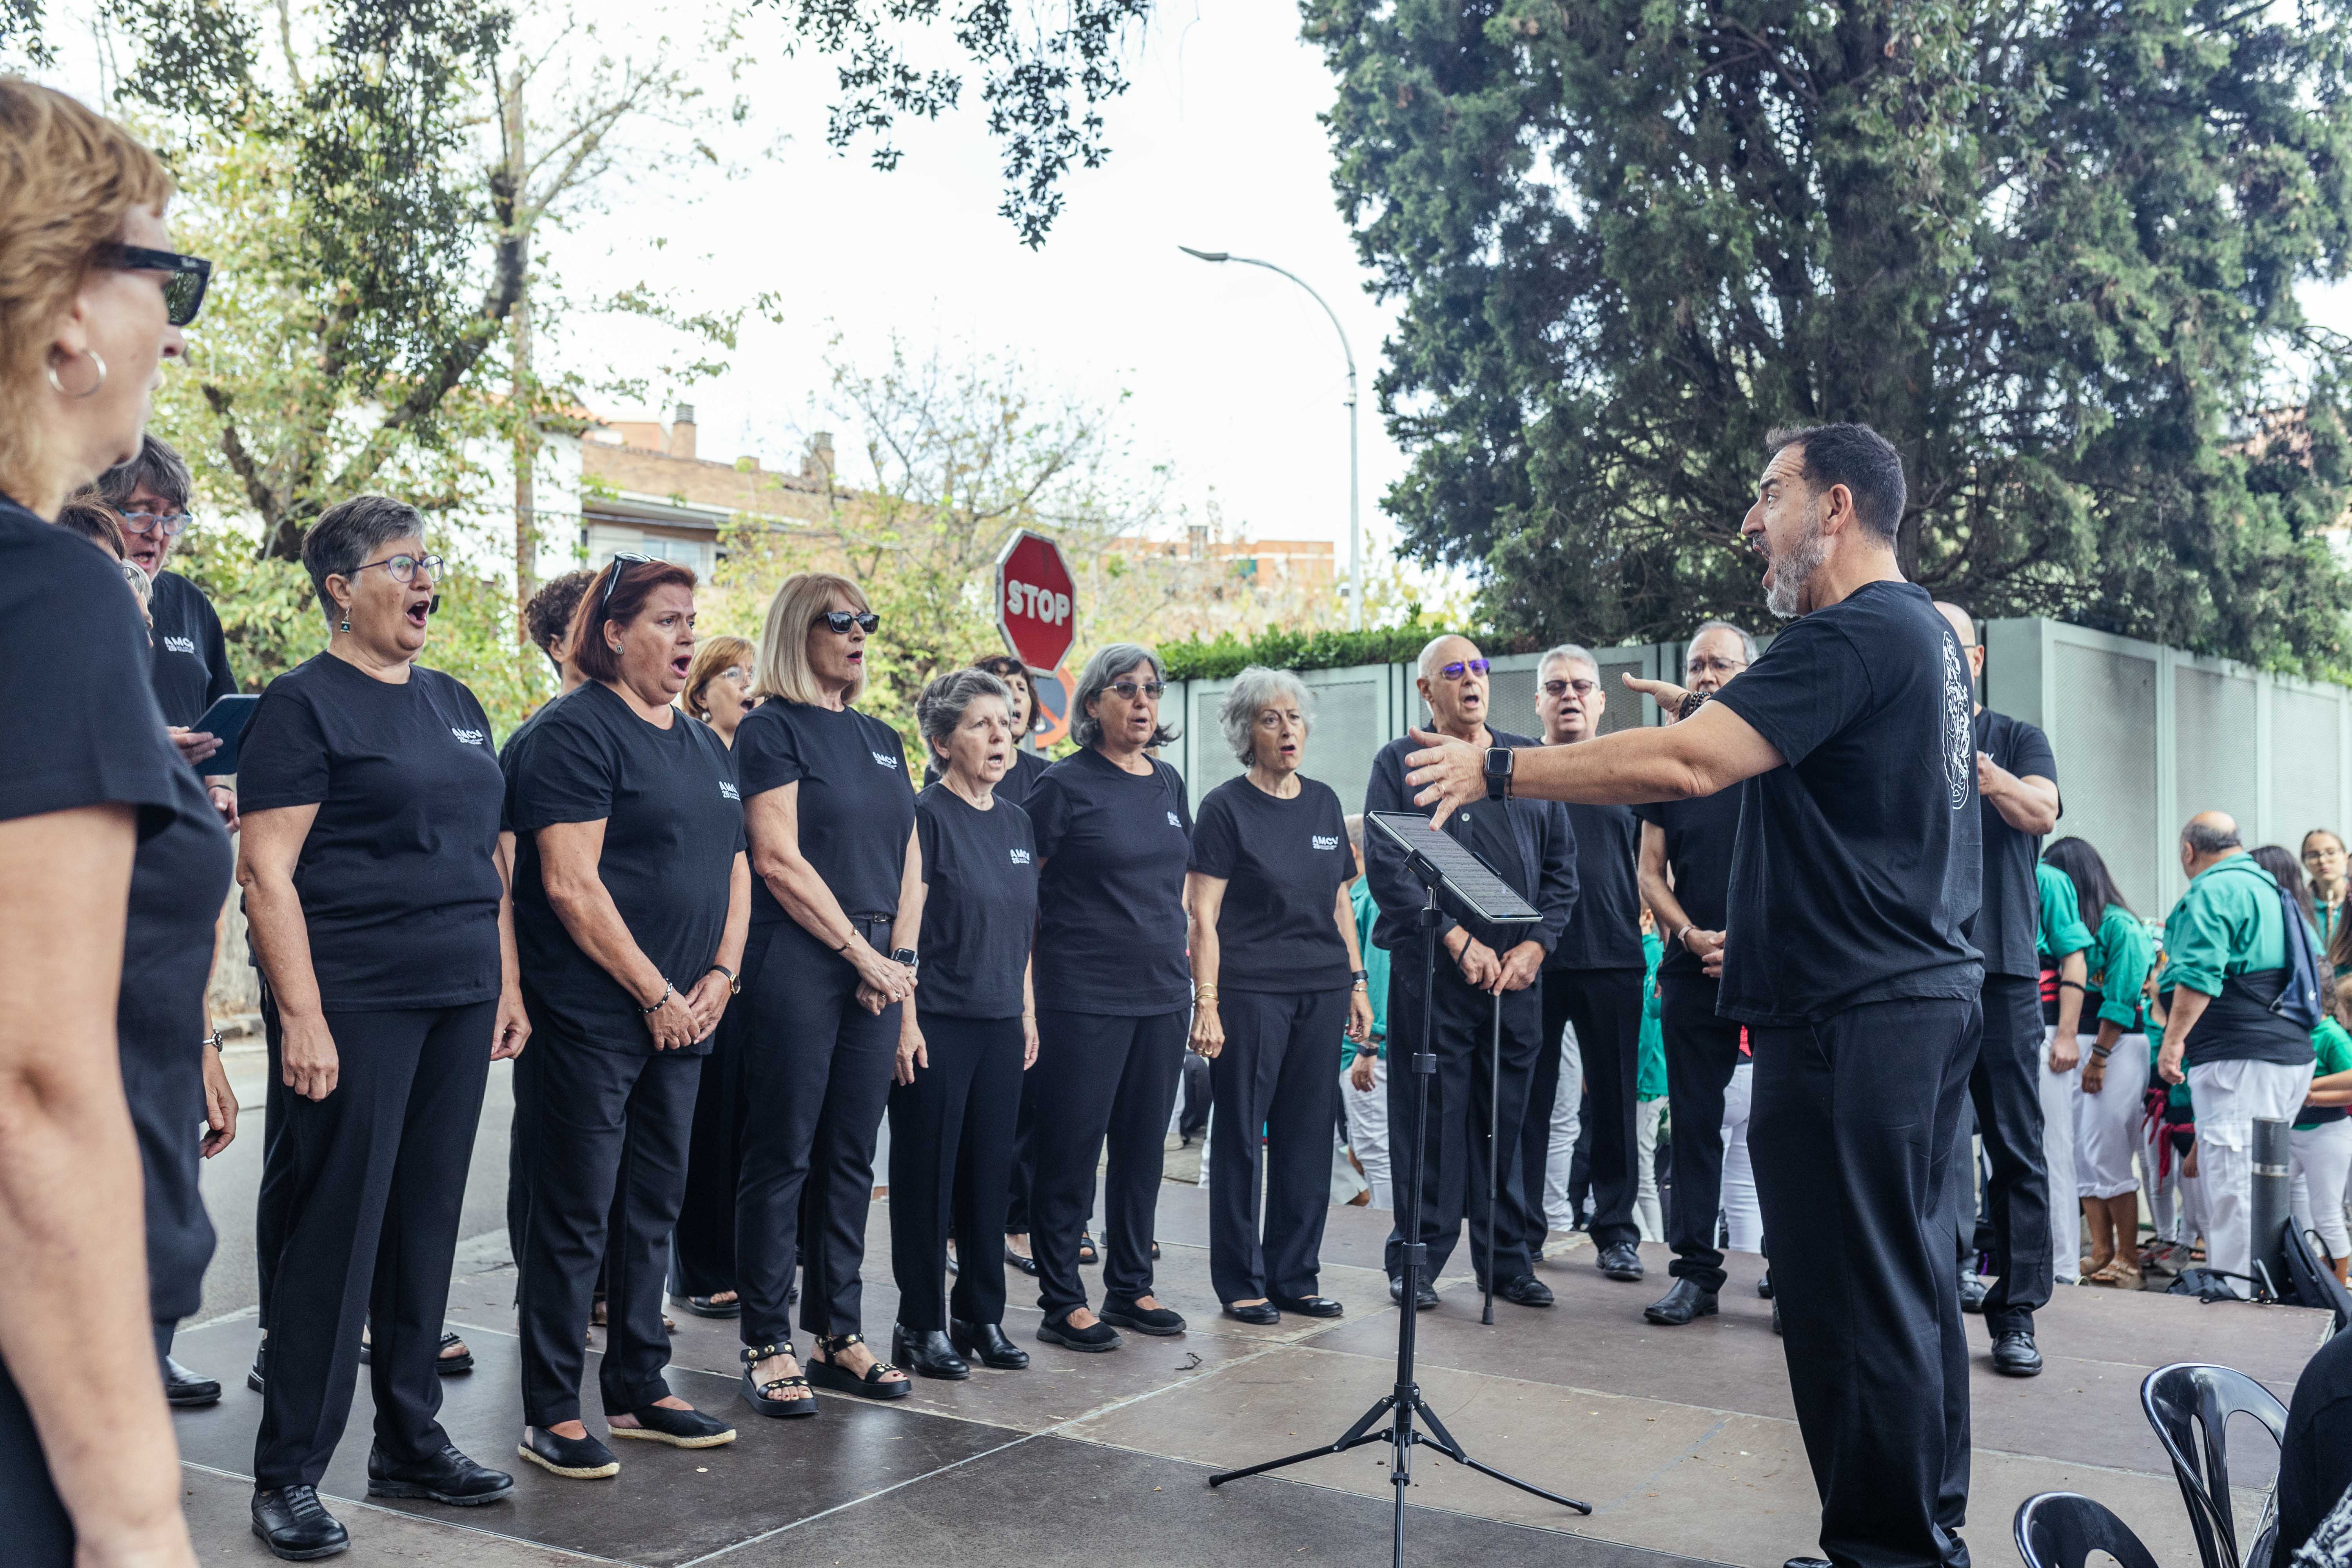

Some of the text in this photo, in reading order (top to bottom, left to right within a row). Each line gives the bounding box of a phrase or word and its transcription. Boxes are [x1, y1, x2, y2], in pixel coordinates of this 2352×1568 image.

[1007, 579, 1070, 626] STOP
[452, 728, 483, 739] AMCV
[719, 781, 738, 794] AMC
[1312, 835, 1338, 845] AMCV
